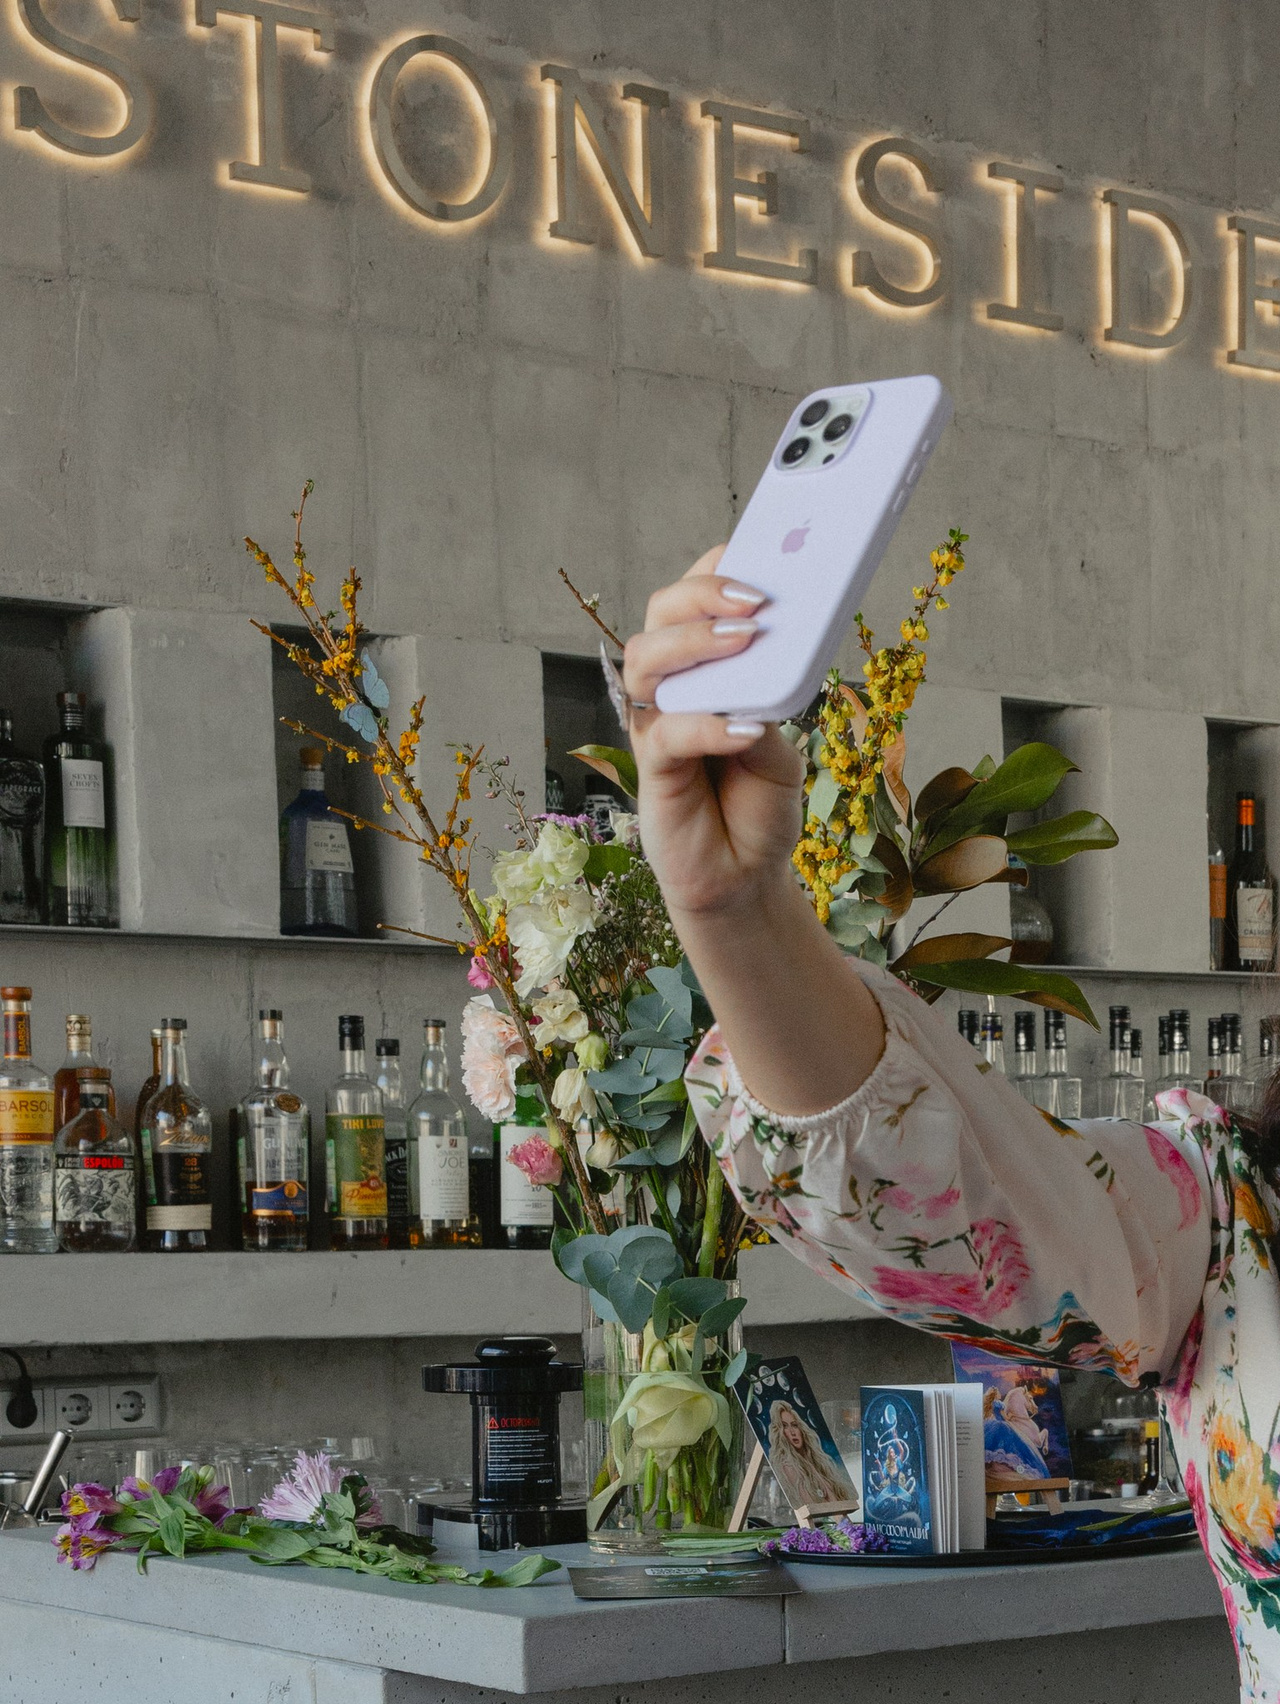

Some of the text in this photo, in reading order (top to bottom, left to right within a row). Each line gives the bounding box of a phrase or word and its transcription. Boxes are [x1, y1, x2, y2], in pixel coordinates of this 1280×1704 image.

[18, 1020, 27, 1052] BARSOL
[0, 1100, 53, 1113] BARSOL
[439, 1157, 465, 1169] JOE
